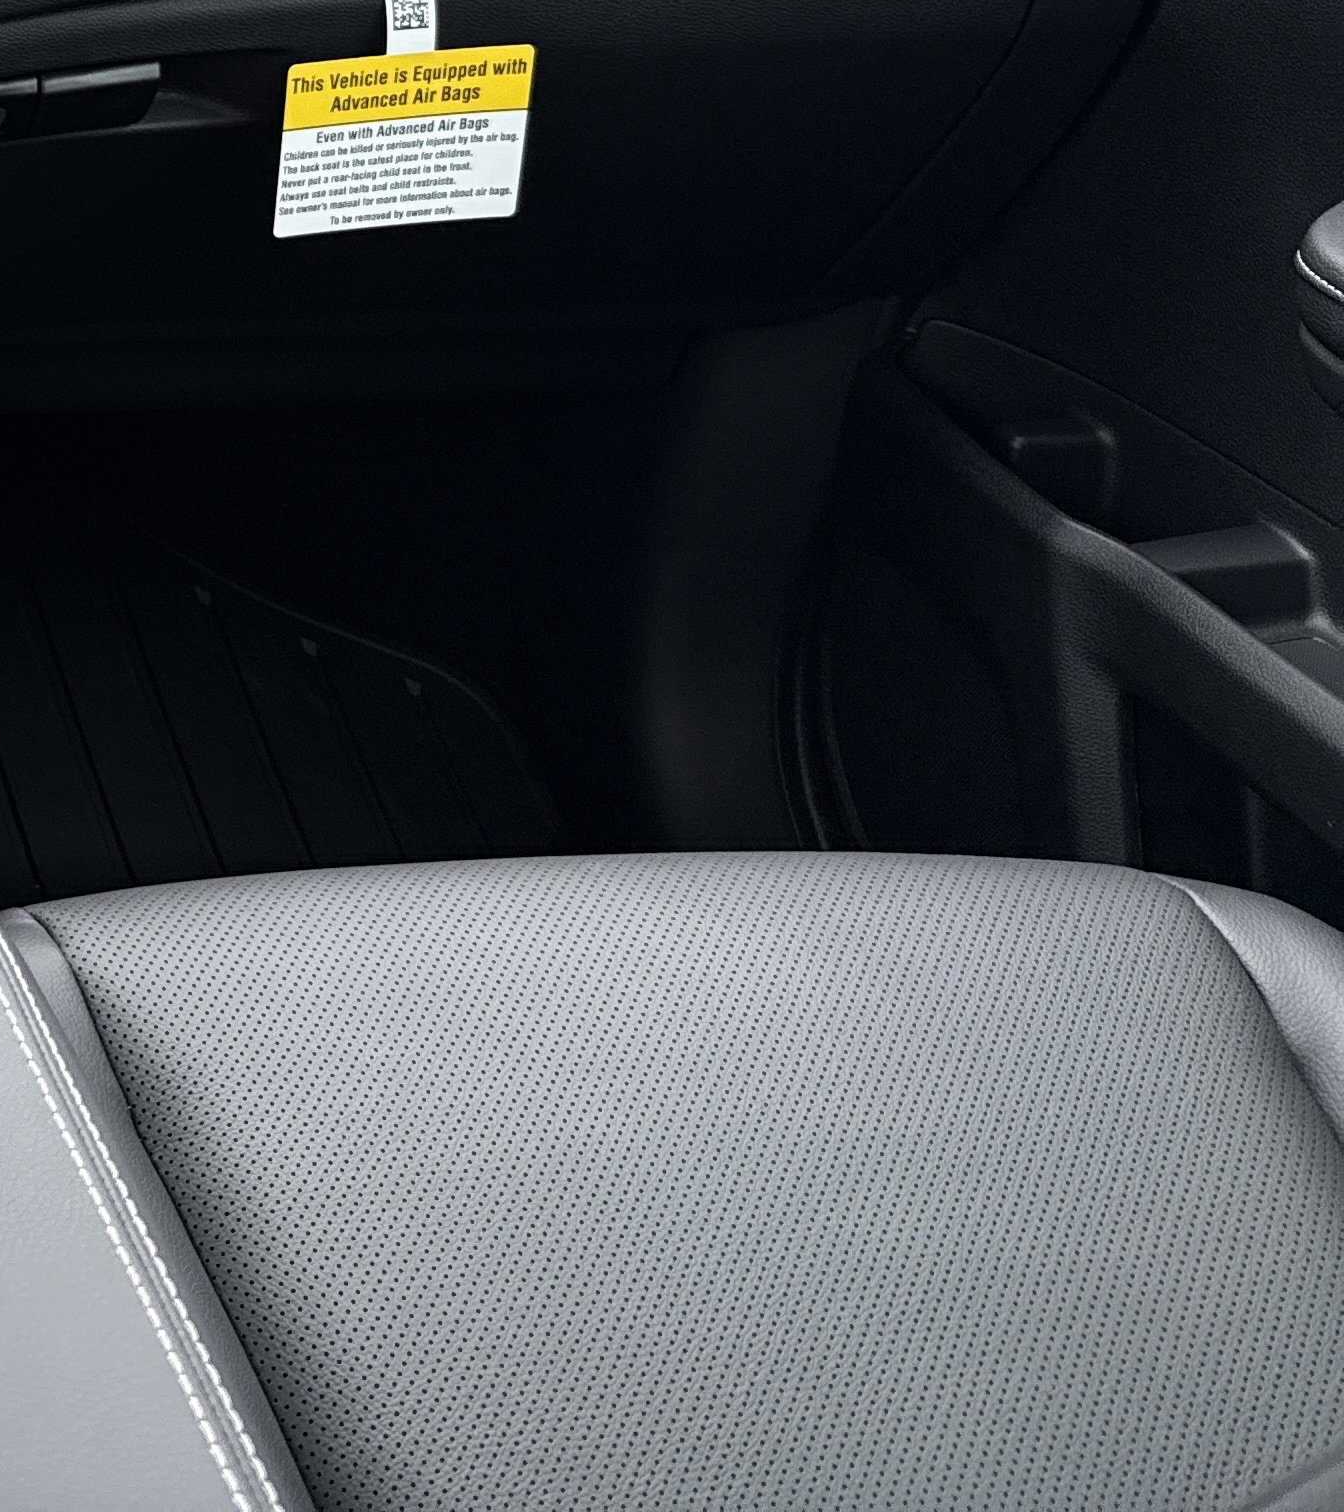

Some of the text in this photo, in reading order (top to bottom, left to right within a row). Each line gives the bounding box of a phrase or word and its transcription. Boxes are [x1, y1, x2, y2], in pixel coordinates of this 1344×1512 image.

[291, 57, 528, 95] This Vehicle is Equipped with
[330, 85, 481, 113] Advanced Air Bags
[316, 117, 490, 144] Even with Advanced Air Bags
[283, 132, 519, 162] Children can be killed or seriously injured by the air bag.
[282, 149, 473, 175] The back seat is the safest place for children.
[281, 179, 306, 189] Never
[307, 176, 321, 187] put
[323, 176, 329, 184] a
[331, 170, 377, 183] rear-facing
[379, 167, 400, 178] child
[402, 165, 421, 175] seat
[422, 165, 432, 174] in
[433, 163, 447, 172] the
[278, 206, 295, 216] See
[330, 198, 361, 209] manual
[362, 196, 374, 207] for
[375, 195, 397, 205] more
[400, 190, 448, 203] information
[449, 188, 473, 198] about
[474, 187, 487, 196] air
[279, 192, 309, 203] Always
[311, 190, 327, 199] use
[328, 187, 347, 197] seat
[348, 184, 370, 195] belts
[371, 182, 388, 192] and
[389, 180, 411, 190] child
[330, 205, 456, 226] To be removed by owner only.
